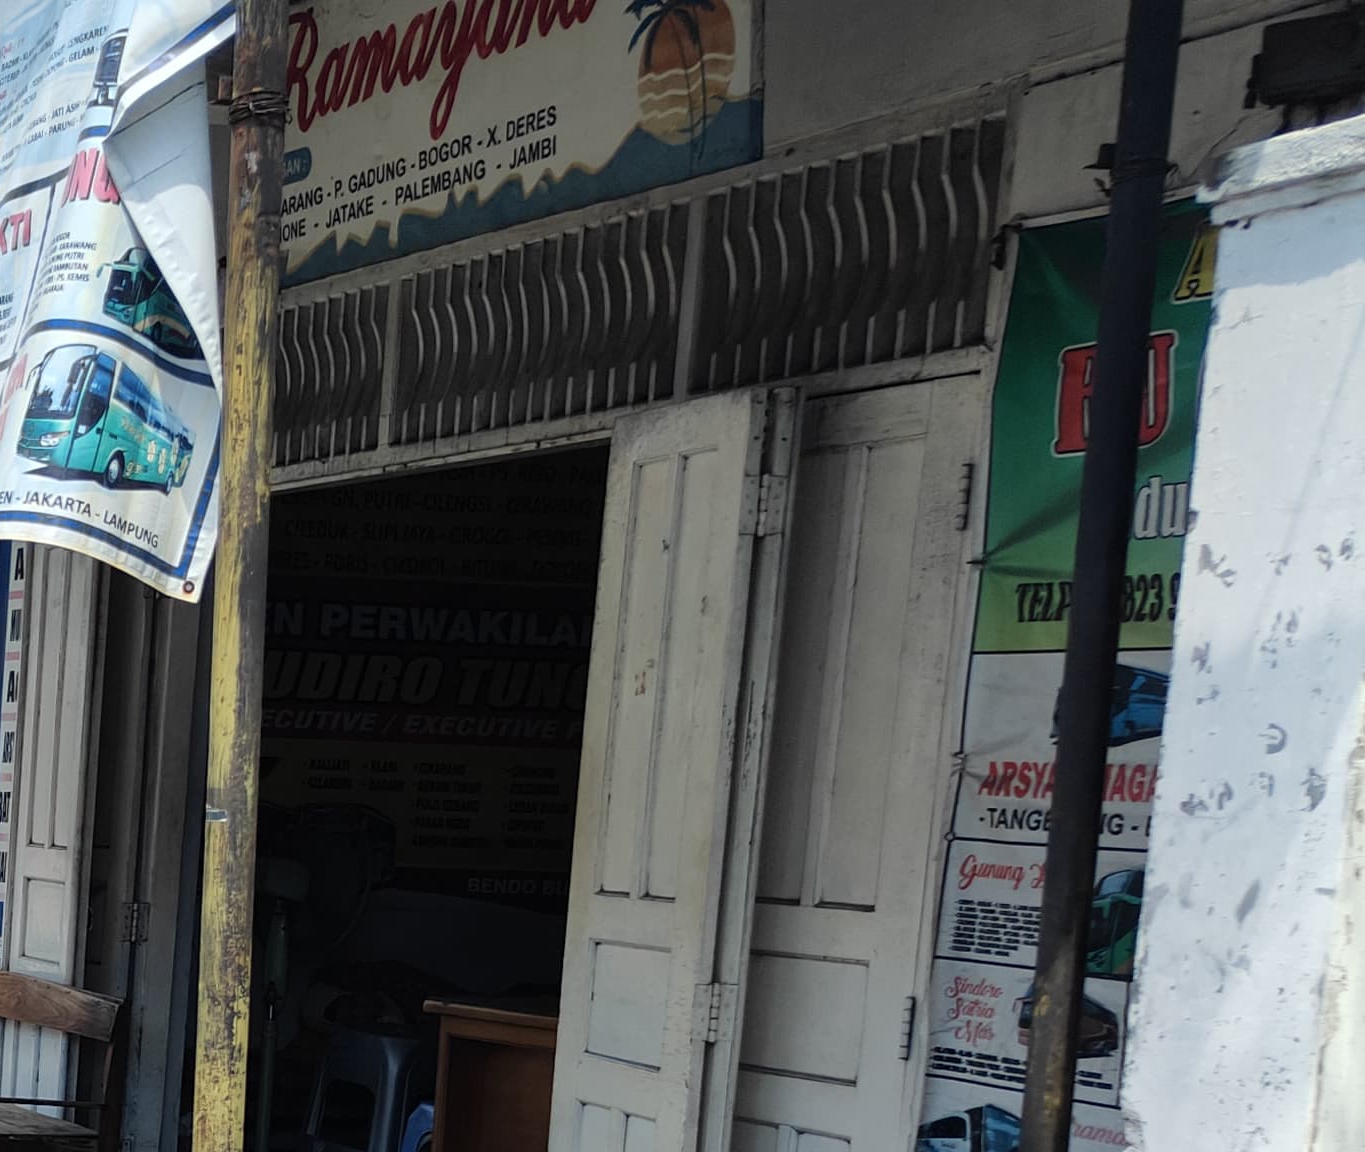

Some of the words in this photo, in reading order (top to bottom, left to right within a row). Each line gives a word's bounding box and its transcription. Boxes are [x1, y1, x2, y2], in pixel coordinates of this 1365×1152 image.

[347, 156, 407, 197] GADUNG
[417, 134, 473, 171] BOGOR
[504, 104, 558, 145] DERES
[325, 195, 375, 228] JATAKE
[395, 159, 487, 205] PALEMBANG
[508, 135, 557, 171] JAMBI
[22, 491, 92, 518] JAKARTA
[102, 511, 159, 549] LAMPUNG
[402, 714, 565, 739] EXECUTIVE
[977, 760, 1054, 800] ARSYA
[958, 853, 1025, 891] Gunung
[945, 976, 1004, 999] Sindoro
[948, 998, 997, 1021] Satria
